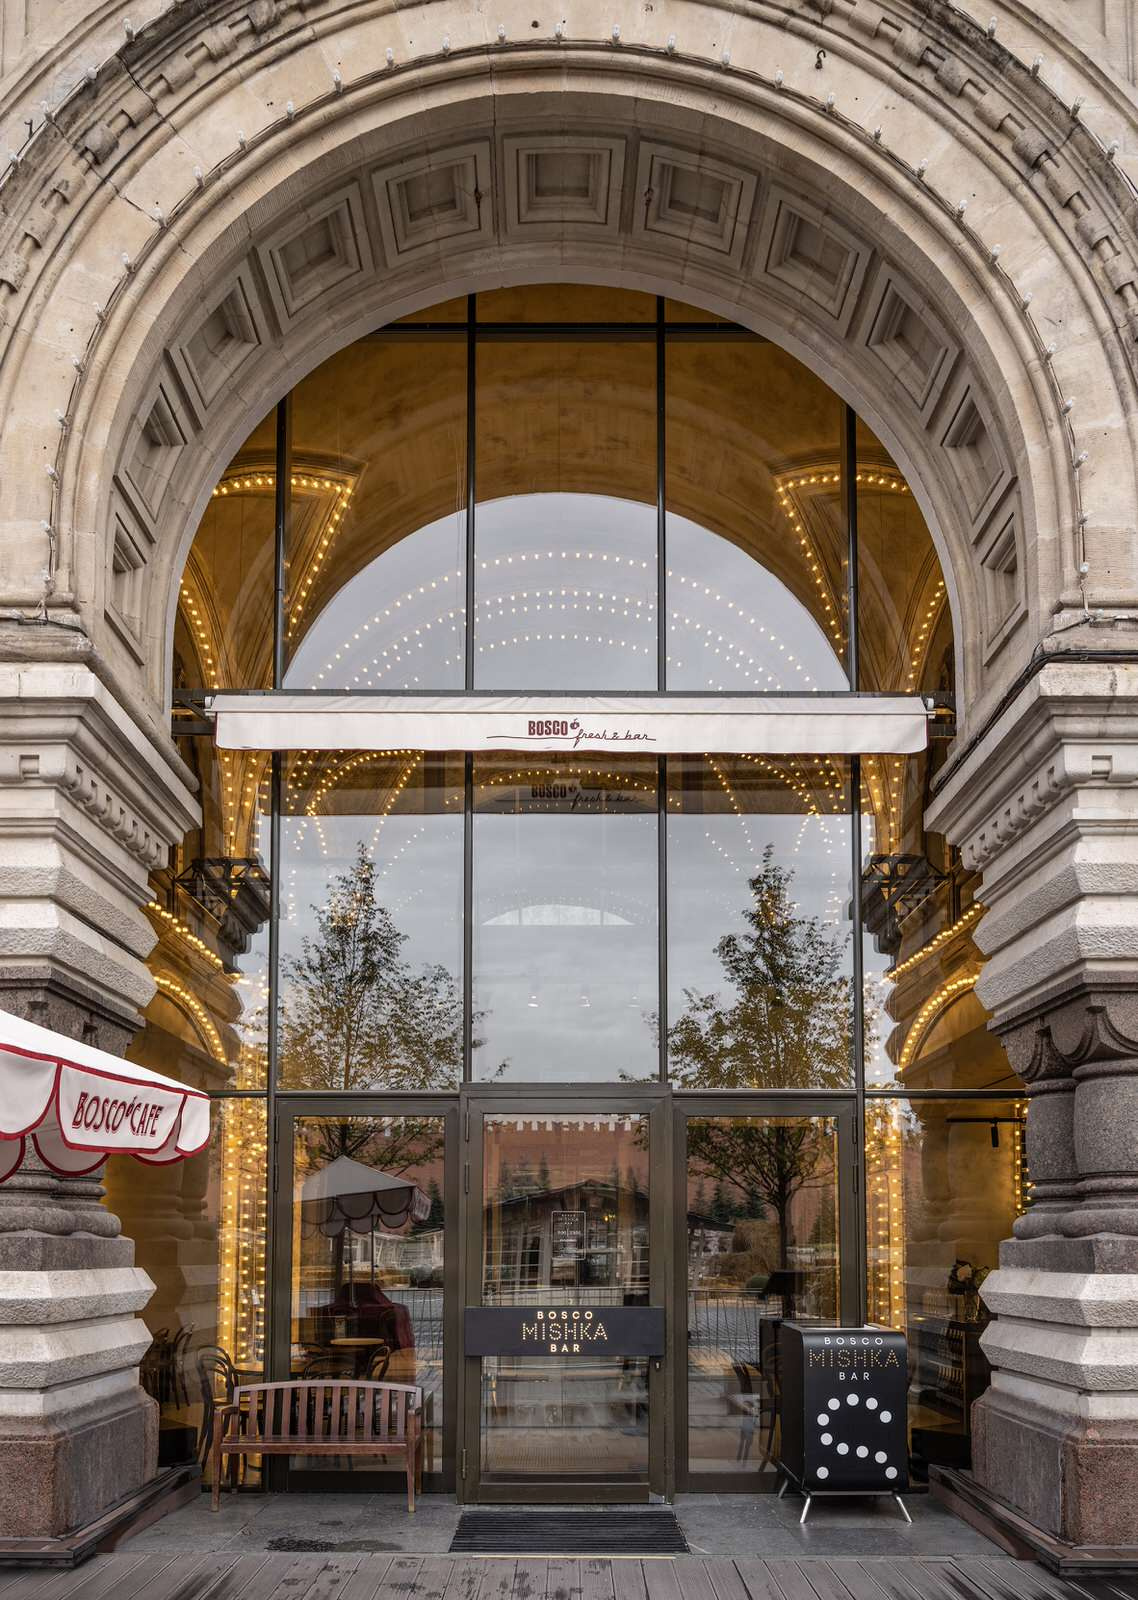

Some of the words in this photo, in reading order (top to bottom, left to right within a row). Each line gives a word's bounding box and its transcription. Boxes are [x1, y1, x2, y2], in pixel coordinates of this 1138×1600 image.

[528, 720, 569, 736] BOSCO
[573, 729, 608, 748] fresh
[610, 732, 620, 741] &
[623, 730, 655, 741] bar
[72, 1091, 126, 1133] BOSCO
[130, 1101, 164, 1137] CAFE
[537, 1311, 593, 1320] BOSCO
[522, 1322, 608, 1340] MISHKA
[824, 1336, 883, 1345] BOSCO
[550, 1343, 580, 1353] BAR
[809, 1349, 900, 1368] MISHKA
[839, 1371, 870, 1381] BAR
